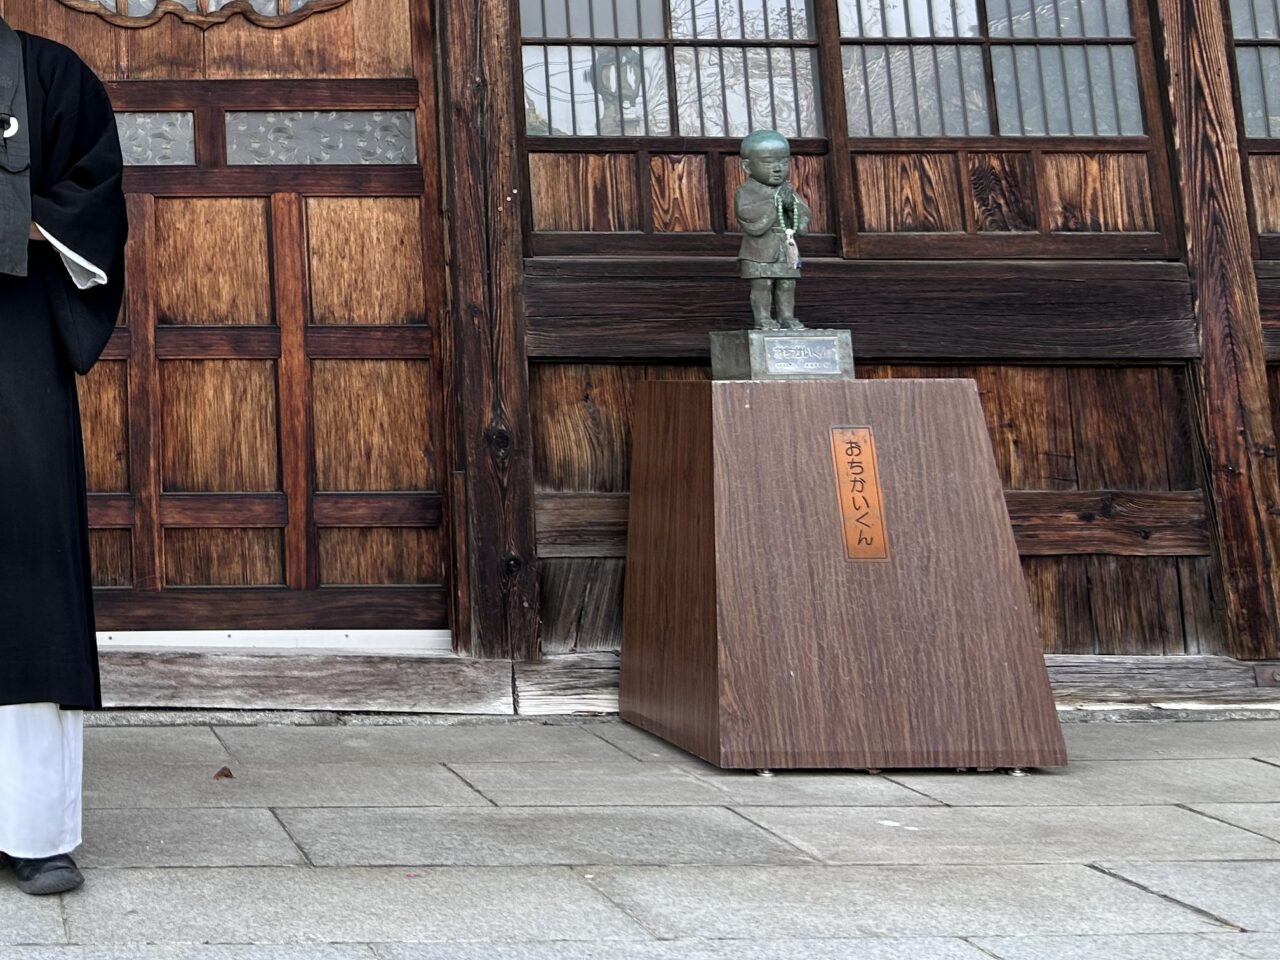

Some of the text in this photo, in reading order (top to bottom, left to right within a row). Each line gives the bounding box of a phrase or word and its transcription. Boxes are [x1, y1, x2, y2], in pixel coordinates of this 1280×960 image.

[845, 440, 873, 546] おちかいくん
